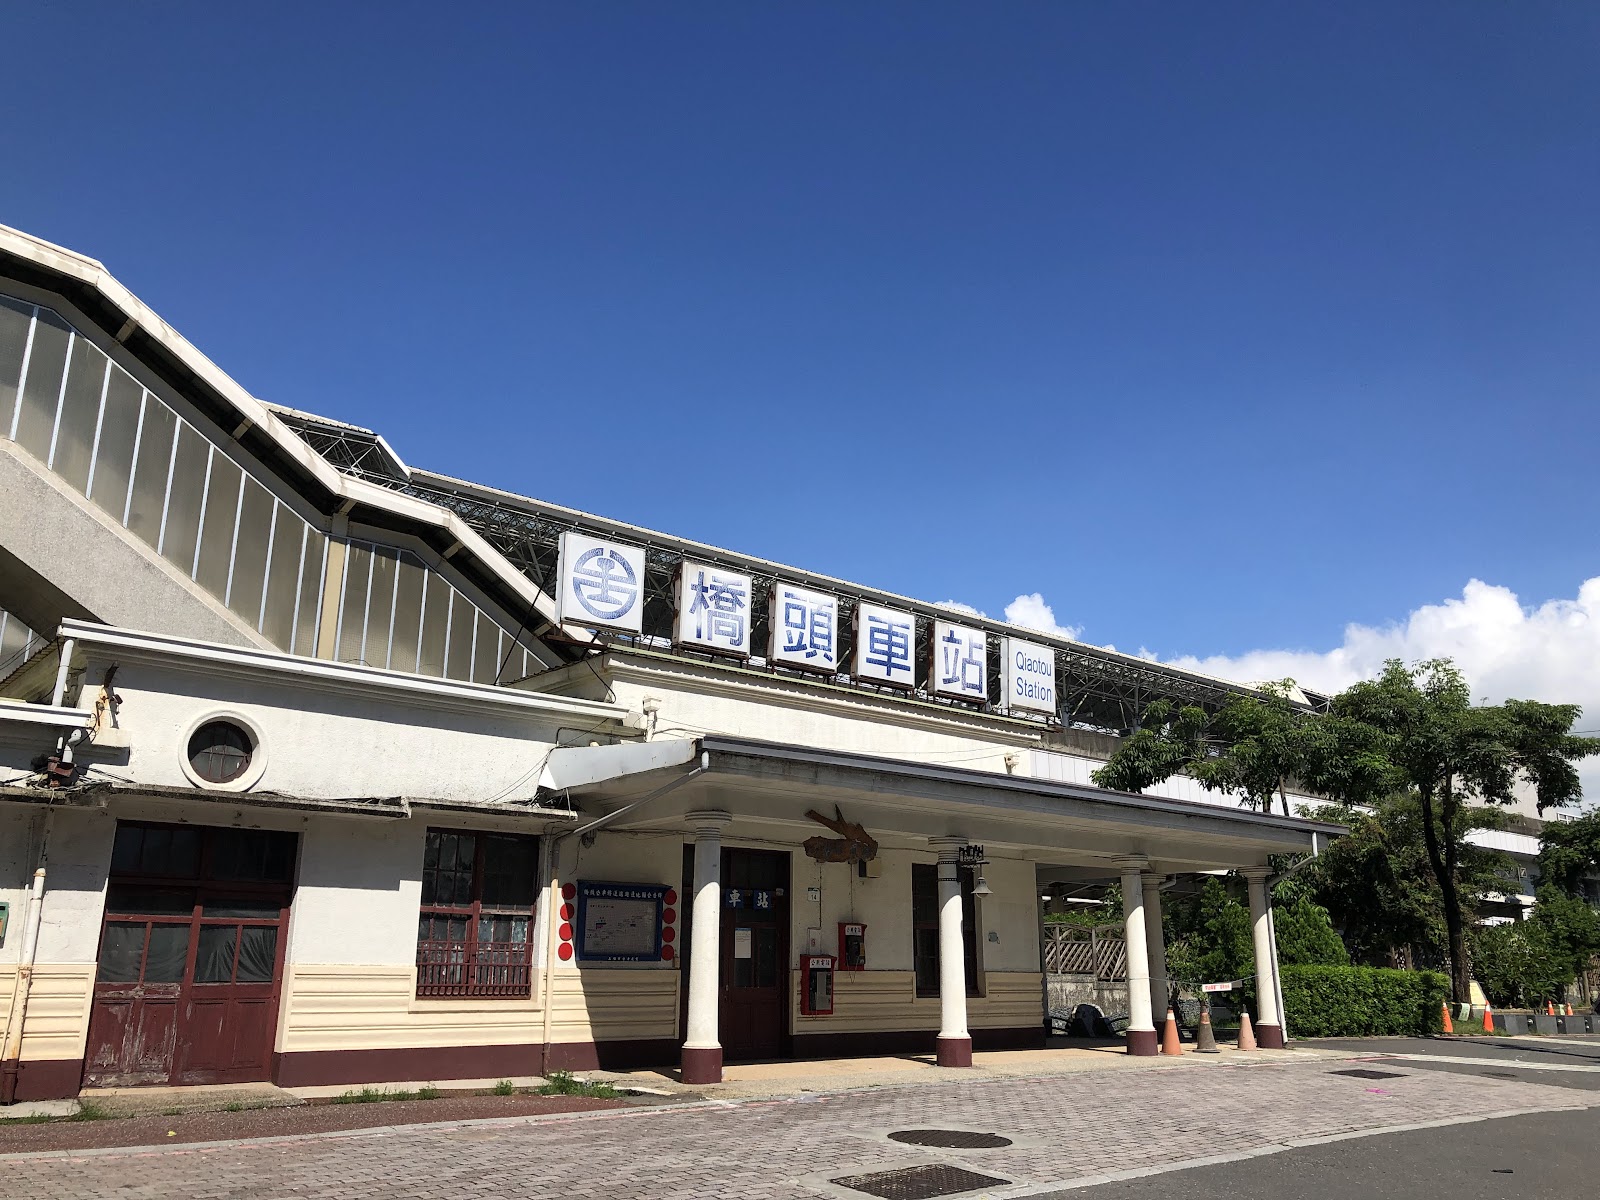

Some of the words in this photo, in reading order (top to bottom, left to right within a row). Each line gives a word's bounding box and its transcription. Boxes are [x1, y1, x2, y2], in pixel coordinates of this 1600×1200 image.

[689, 571, 984, 694] 橋頭車站
[1015, 651, 1052, 677] Qiaotou
[1016, 676, 1052, 702] Station
[728, 888, 769, 909] 車站
